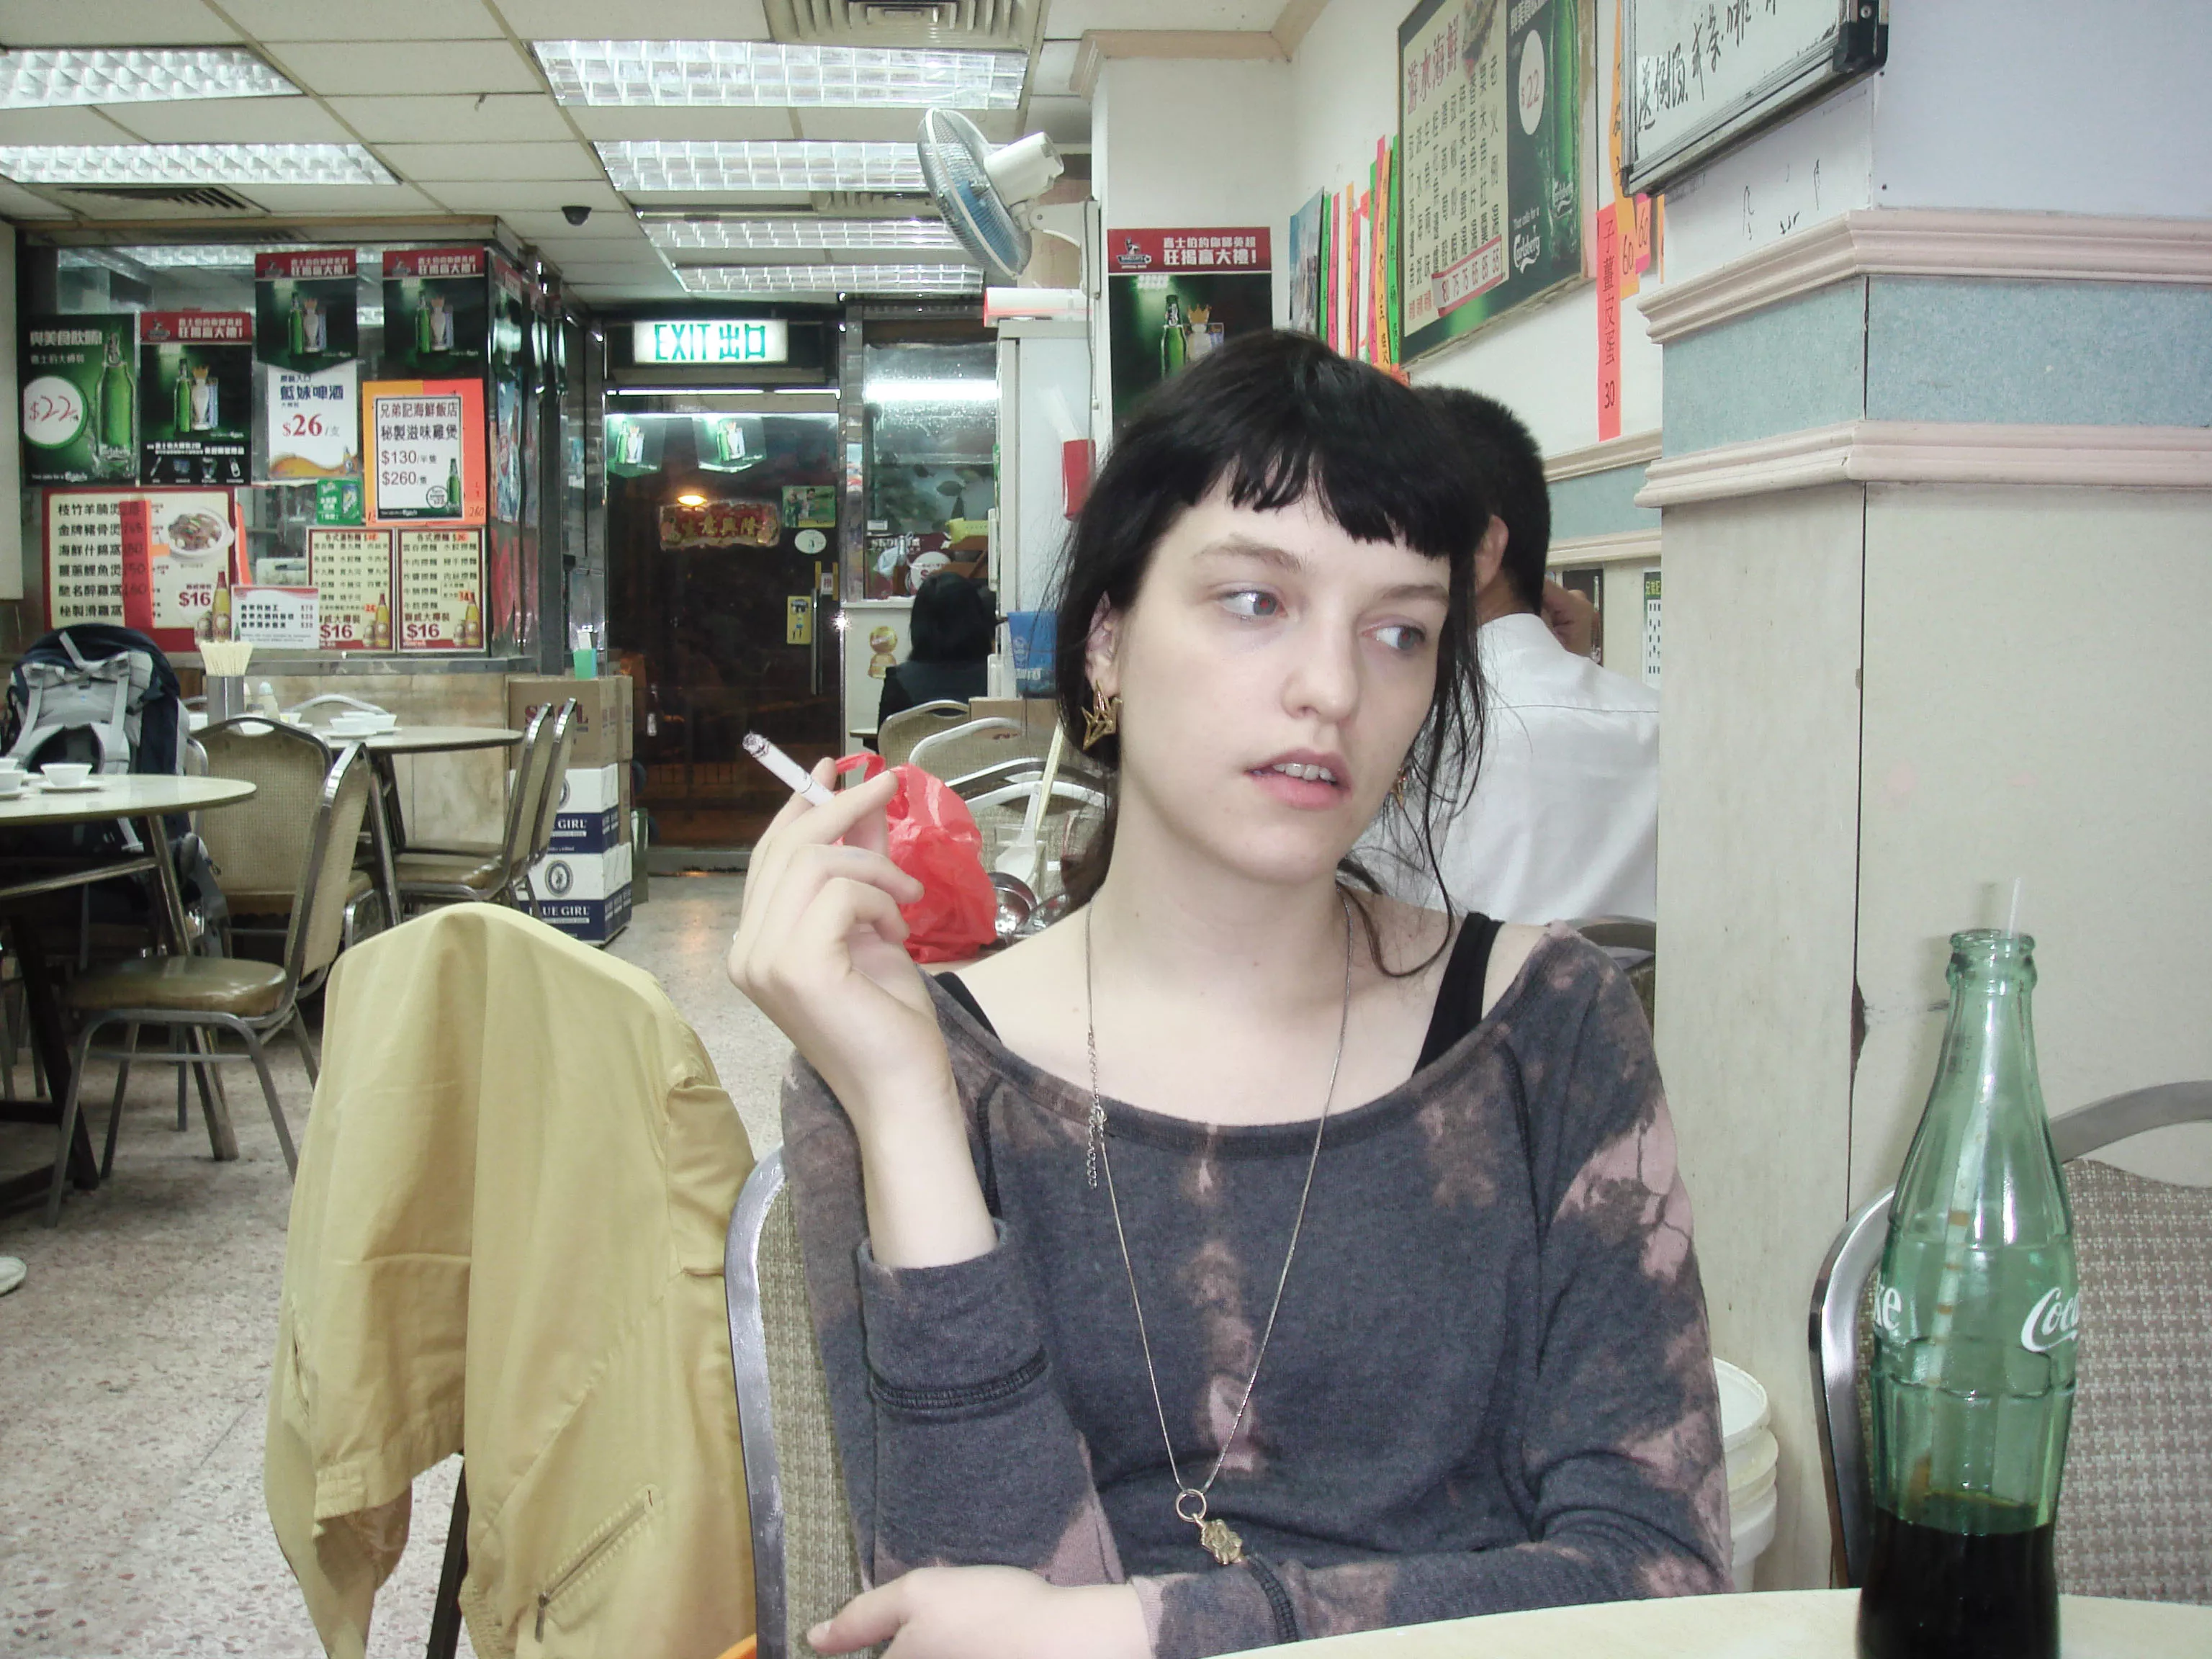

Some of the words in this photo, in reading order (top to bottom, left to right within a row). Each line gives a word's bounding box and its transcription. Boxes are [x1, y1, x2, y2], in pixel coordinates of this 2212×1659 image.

[1637, 207, 1649, 248] 60
[1514, 233, 1541, 274] Carlsberg
[1622, 235, 1634, 275] 60
[654, 323, 711, 361] EXIT
[719, 323, 766, 360] 出口
[1604, 379, 1616, 410] 30
[29, 395, 77, 422] $22
[380, 402, 458, 418] 兄弟記海鮮飯店
[178, 591, 211, 608] $16
[320, 624, 353, 639] $16
[406, 623, 440, 639] $16
[557, 819, 587, 830] GIRL
[560, 907, 590, 917] GIRL
